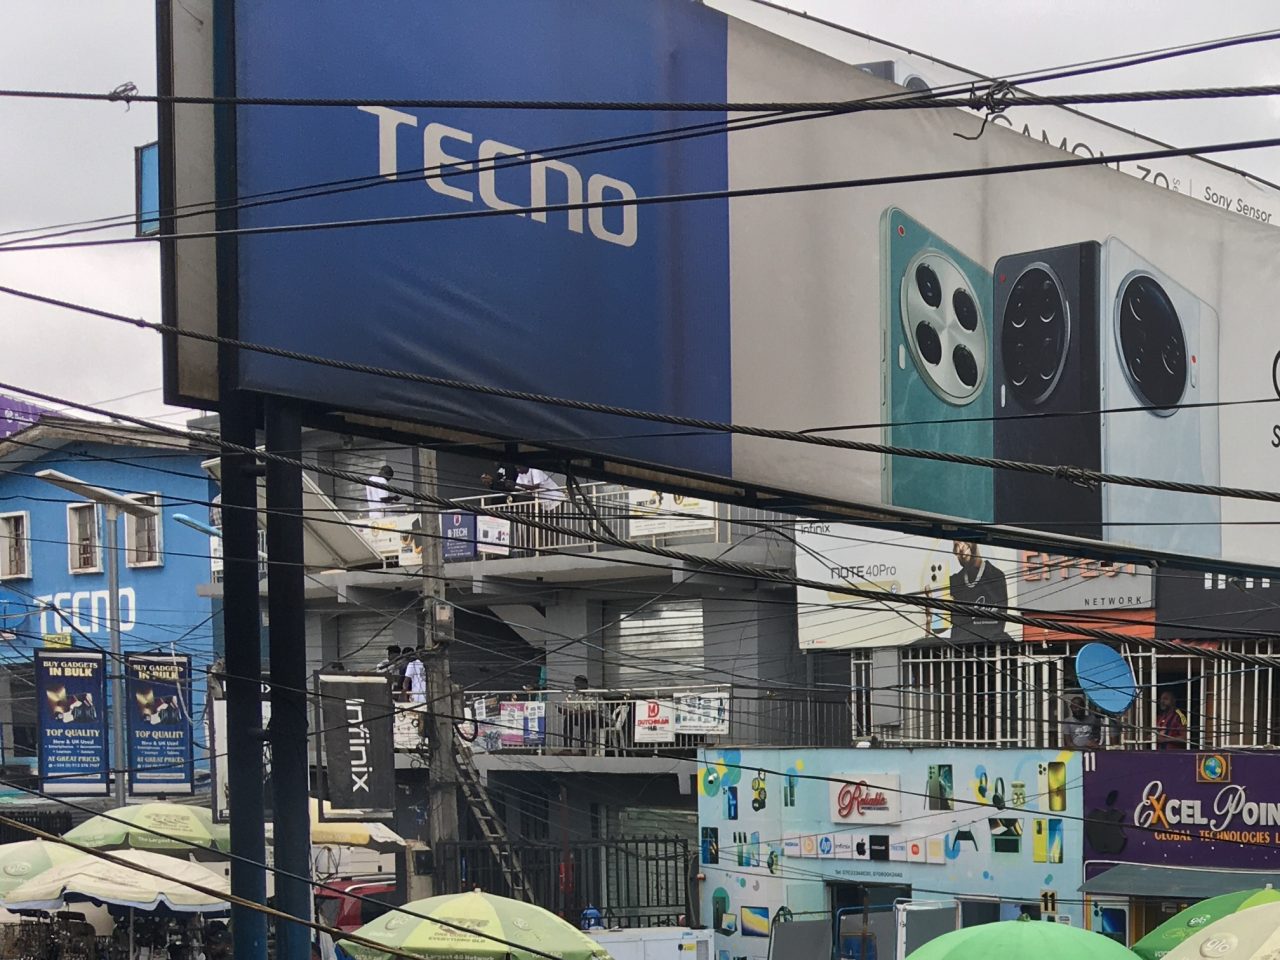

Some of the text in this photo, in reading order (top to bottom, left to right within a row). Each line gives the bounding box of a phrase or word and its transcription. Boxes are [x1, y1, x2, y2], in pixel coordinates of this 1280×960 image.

[357, 105, 638, 247] TECNO
[1204, 186, 1272, 224] Sony Sensor
[866, 565, 897, 578] 40Pro
[1085, 595, 1144, 606] NETWORK
[33, 586, 137, 636] TECNO
[43, 660, 98, 669] BUY GADGETS
[49, 668, 92, 677] IN BULK
[45, 729, 100, 737] TOP QUALITY
[135, 730, 184, 739] TOP QUALITY
[345, 698, 373, 793] Infinix
[1084, 752, 1096, 772] 11
[1134, 780, 1209, 829] EXCEL
[1154, 830, 1193, 842] GLOBAL
[1199, 830, 1270, 844] TECHNOLOGIES
[1042, 892, 1056, 911] 11
[1205, 937, 1231, 957] glo
